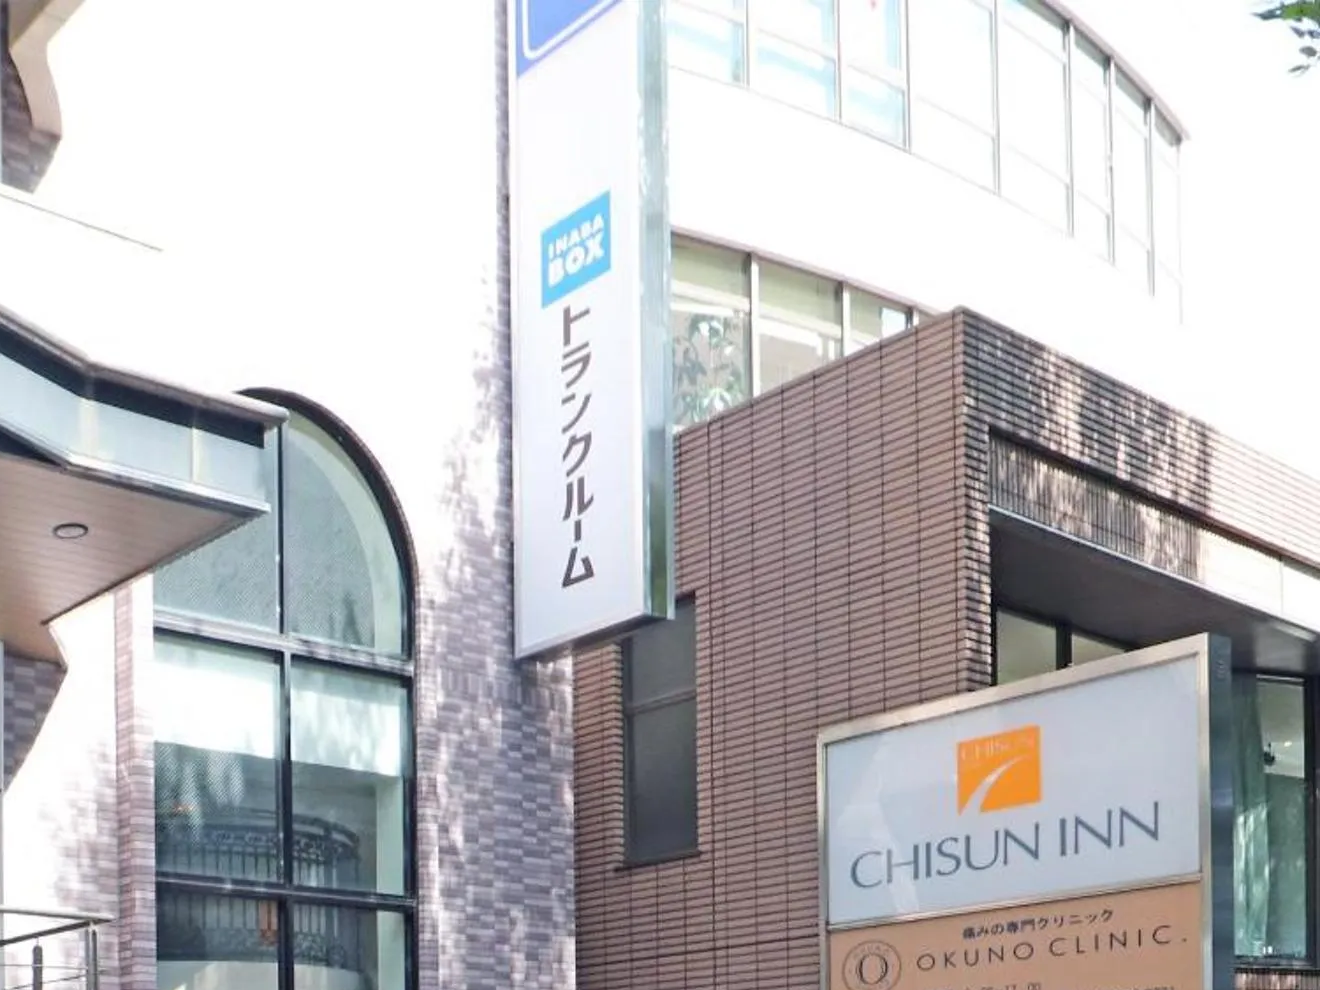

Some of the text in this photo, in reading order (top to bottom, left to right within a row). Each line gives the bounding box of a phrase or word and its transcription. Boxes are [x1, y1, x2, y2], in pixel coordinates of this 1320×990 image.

[548, 213, 605, 261] INABA
[548, 233, 605, 288] BOX
[561, 305, 595, 588] トランクルーム
[850, 801, 1159, 889] CHISUN INN
[916, 942, 1035, 972] OKUNO
